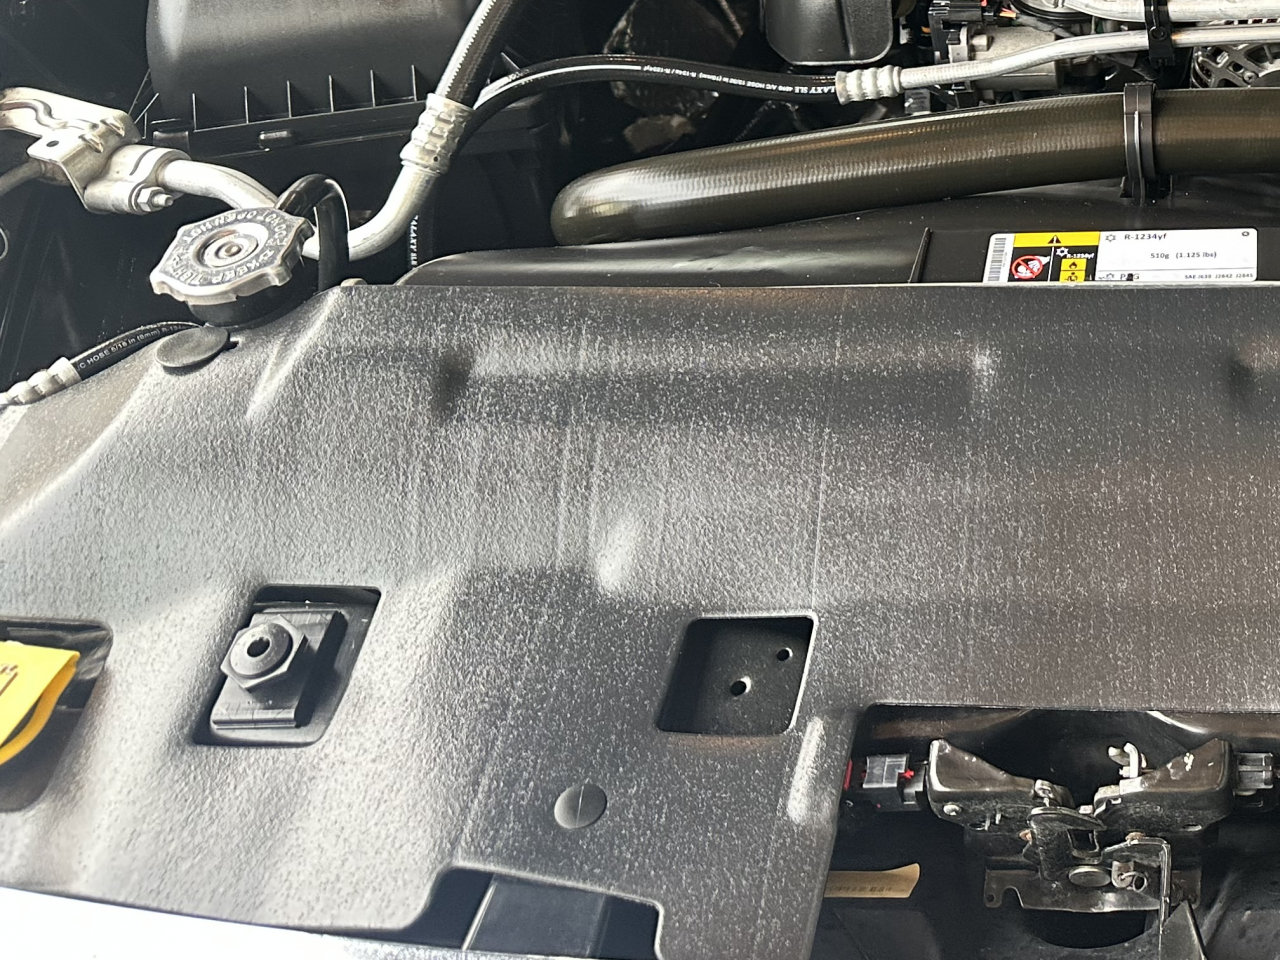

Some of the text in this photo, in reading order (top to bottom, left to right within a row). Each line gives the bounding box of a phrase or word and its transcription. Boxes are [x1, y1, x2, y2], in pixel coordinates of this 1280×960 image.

[746, 81, 766, 89] HOSE
[794, 86, 808, 94] SLE
[808, 86, 836, 94] LAXY
[1124, 233, 1167, 241] R-1234yf
[1150, 251, 1217, 260] 510g (1.125 lbs)
[86, 350, 110, 365] HOSE
